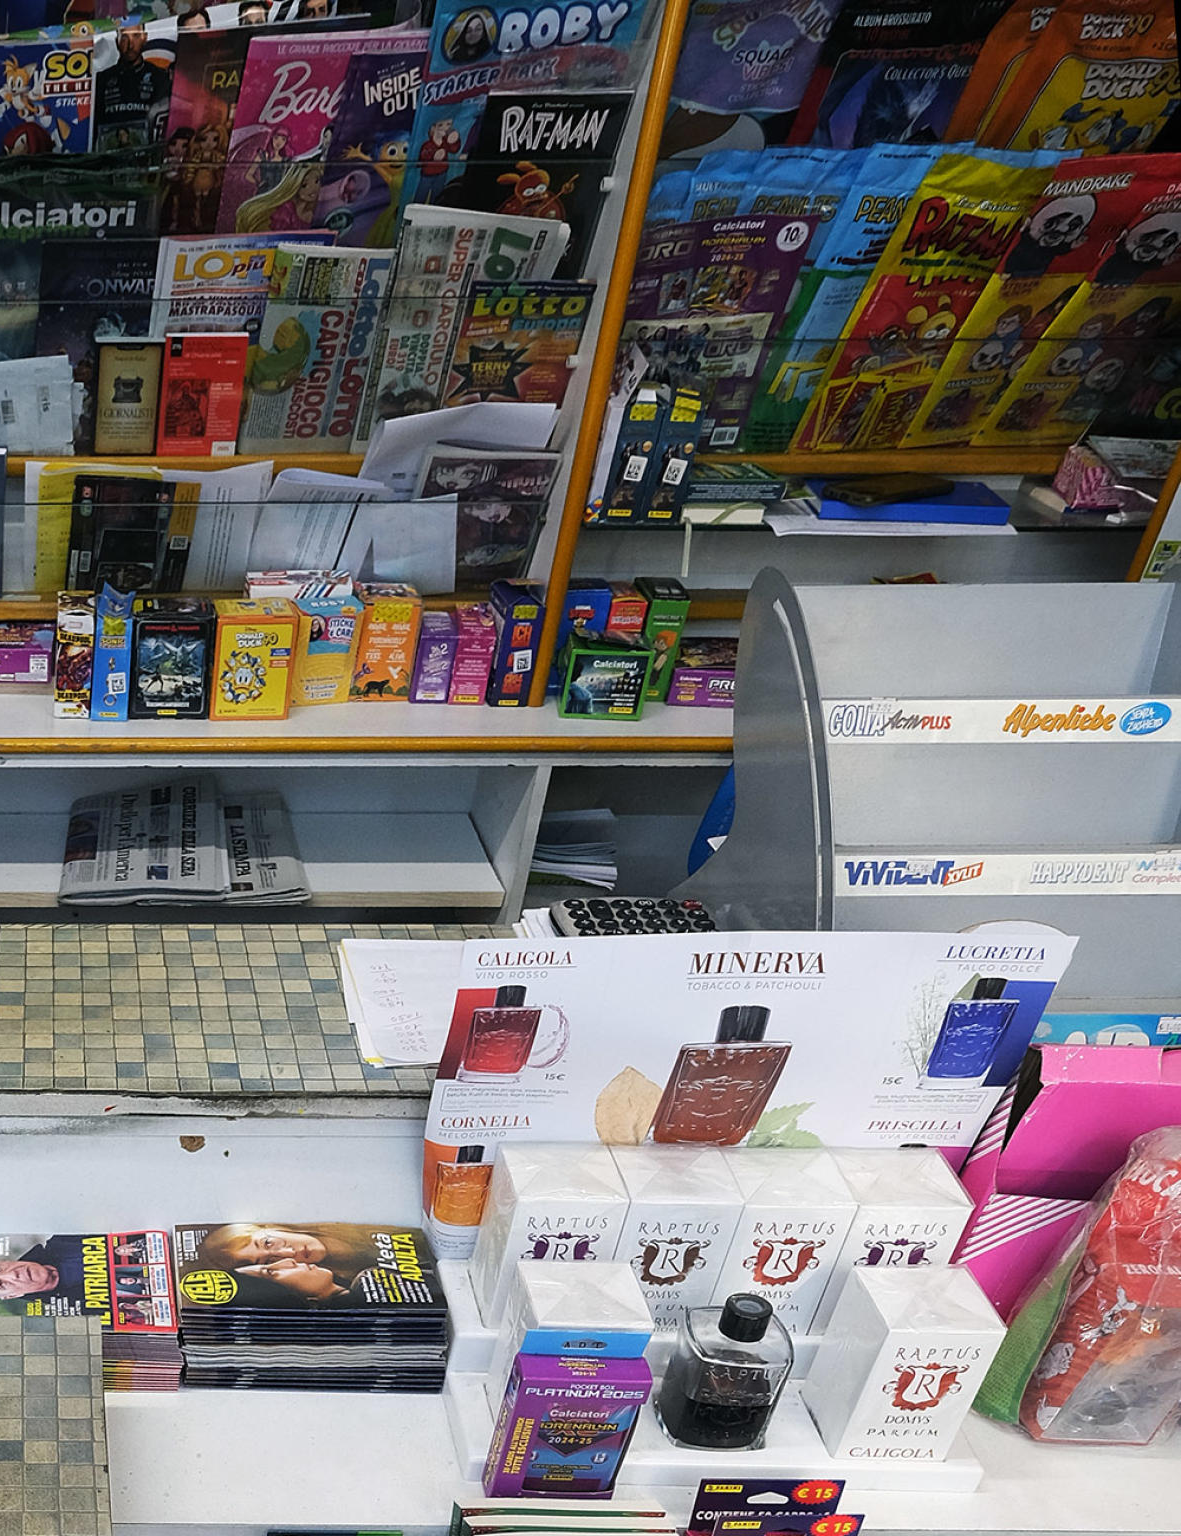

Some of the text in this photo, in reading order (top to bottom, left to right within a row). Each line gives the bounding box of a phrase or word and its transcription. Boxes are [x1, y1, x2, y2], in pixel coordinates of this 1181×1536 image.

[497, 2, 630, 52] ROBY
[853, 11, 932, 27] ALBUM BROSSURATO
[1085, 63, 1162, 81] DONALD
[363, 67, 420, 107] INSIDE
[423, 67, 500, 105] STARTER
[1081, 80, 1149, 99] DUCK
[384, 88, 419, 117] OUT
[500, 105, 610, 153] RAT-MAN
[1042, 172, 1135, 196] MANDRAKE
[712, 219, 765, 233] Calciatori
[446, 228, 474, 283] SUPER
[594, 660, 638, 669] Calciatori
[1002, 703, 1118, 737] Alpenliebe
[231, 825, 252, 877] LA STAMPA
[945, 865, 982, 885] XYLIT
[1029, 861, 1130, 884] HAPPYDENT
[475, 950, 574, 968] CALIGOLA
[945, 944, 1047, 962] LUCRETIA
[688, 951, 826, 978] MINERVA
[956, 962, 1044, 974] TALCO DOLCE
[474, 969, 550, 981] VINO ROSSO
[686, 979, 822, 991] TOBACCO PATCHOULI
[544, 1072, 566, 1083] 15€
[439, 1114, 532, 1130] CORNELIA
[867, 1118, 963, 1133] PRISCILLA
[438, 1129, 508, 1139] MELOGRANO
[526, 1215, 611, 1233] RAPTUS
[753, 1221, 838, 1237] RAPTUS
[376, 1232, 399, 1272] L'età
[392, 1231, 420, 1283] ADULTA
[85, 1237, 107, 1312] PATRIARCA
[189, 1272, 211, 1304] TELE
[895, 1346, 982, 1362] RAPTUS
[526, 1387, 644, 1399] PLATINUM 2025
[550, 1409, 610, 1418] Calciatori
[548, 1436, 593, 1445] 2024-25
[866, 1428, 940, 1439] PARFUM
[849, 1446, 935, 1459] CALIGOLA
